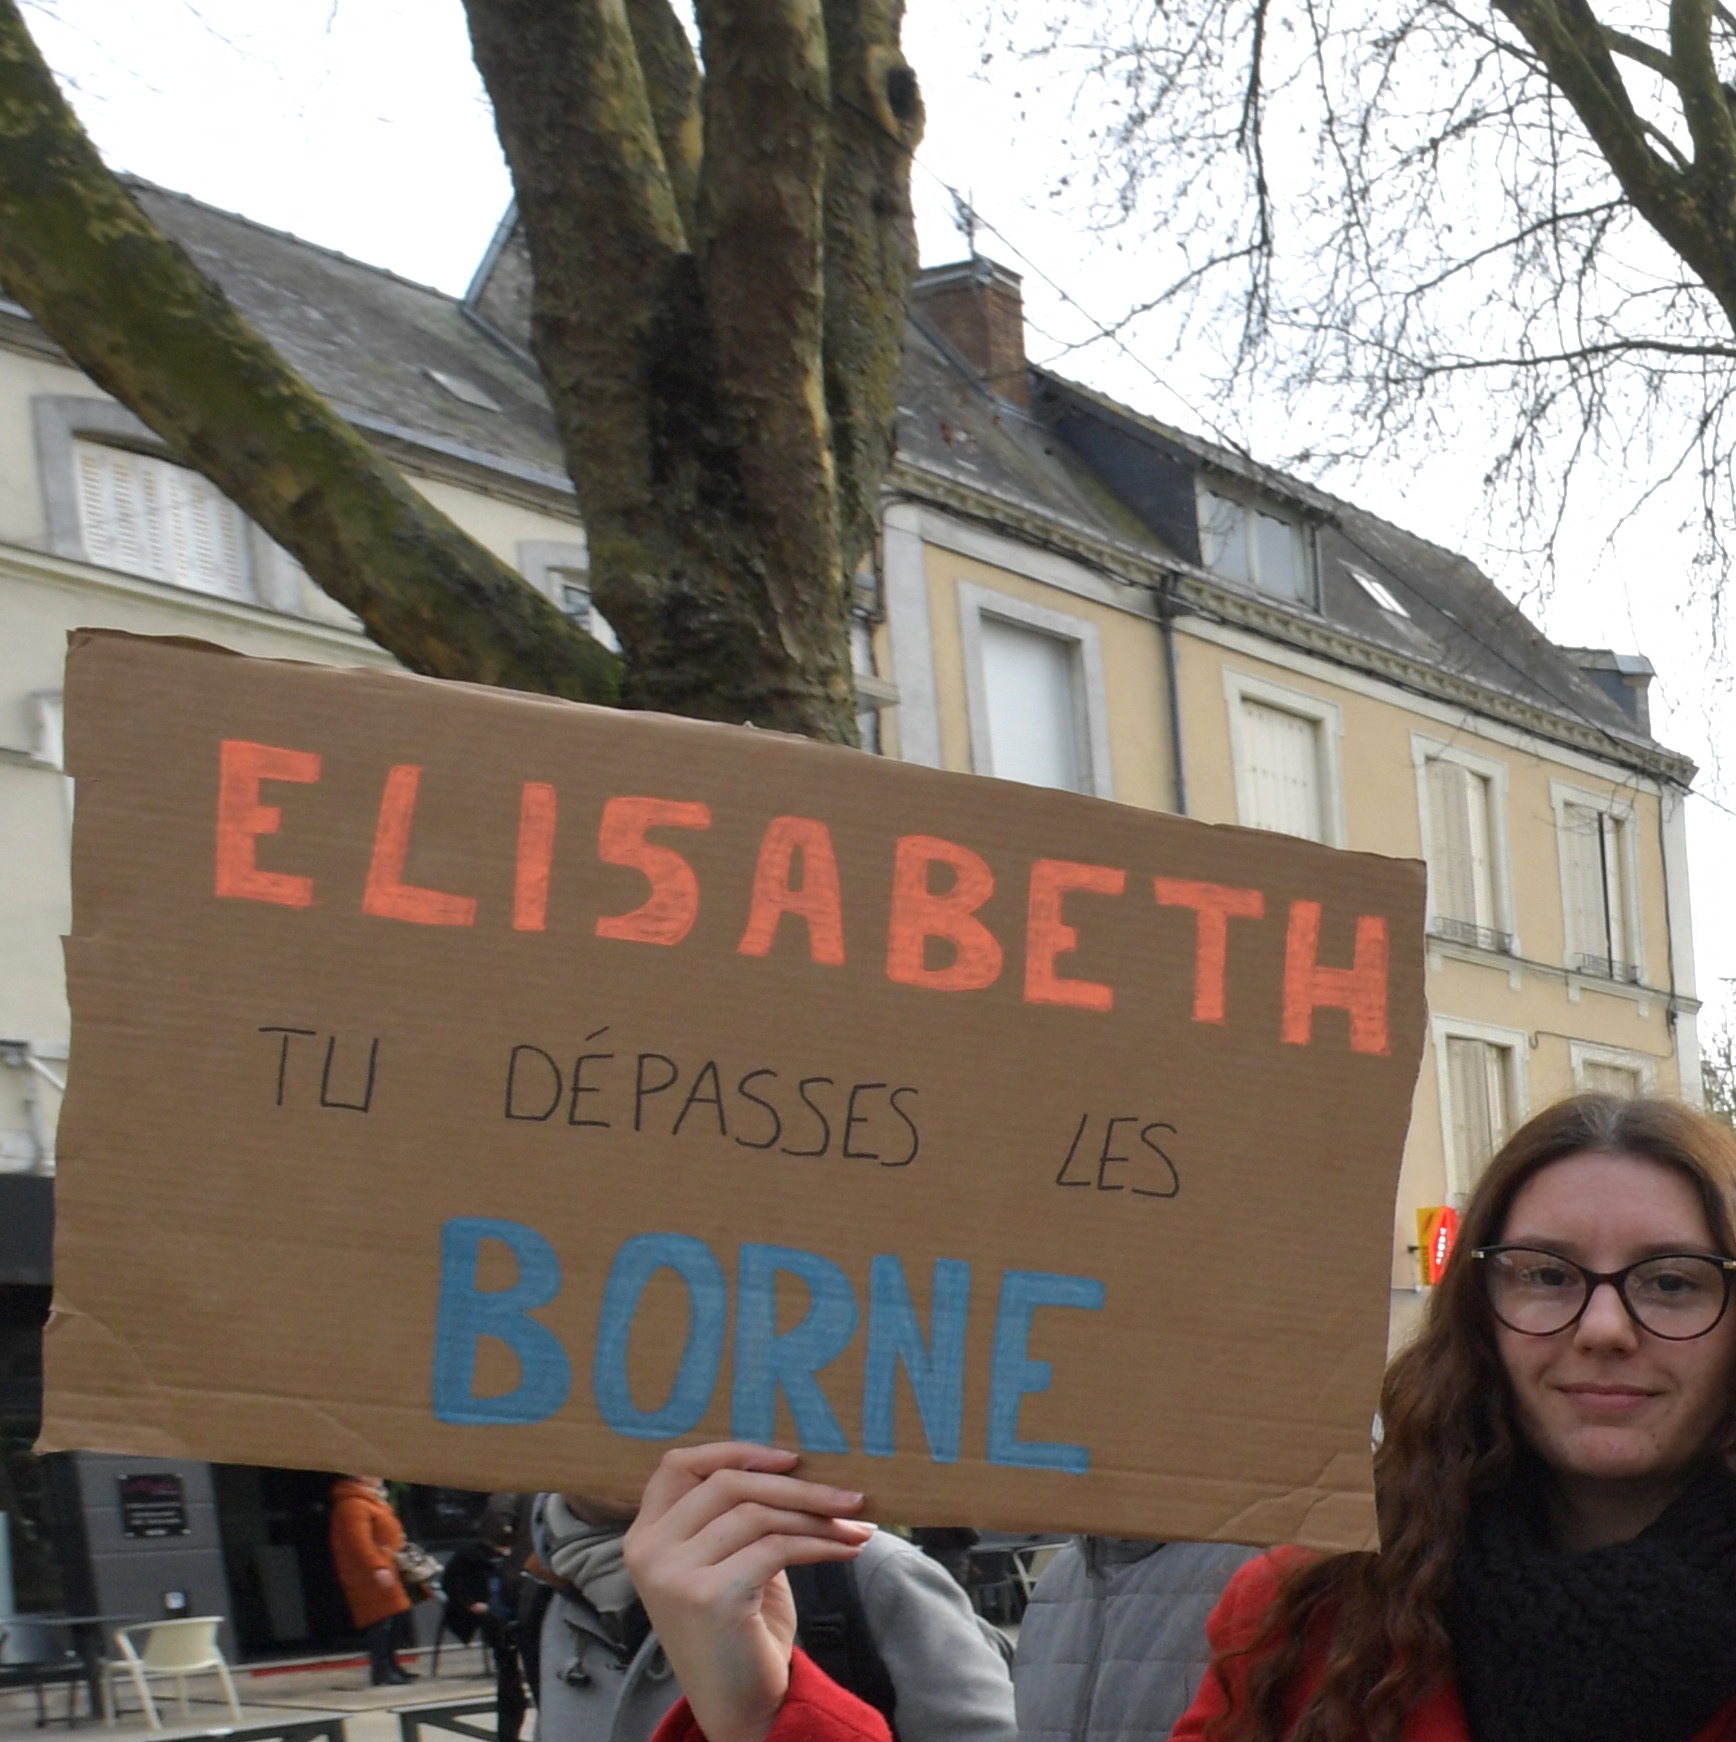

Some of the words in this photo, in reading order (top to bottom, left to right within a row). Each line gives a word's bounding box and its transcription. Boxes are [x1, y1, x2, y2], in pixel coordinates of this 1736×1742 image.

[218, 740, 1391, 1055] ELISABETH
[258, 1027, 380, 1114] TU
[505, 1026, 919, 1168] DÉPASSES
[1055, 1114, 1180, 1199] LES
[432, 1217, 1106, 1475] BORNE
